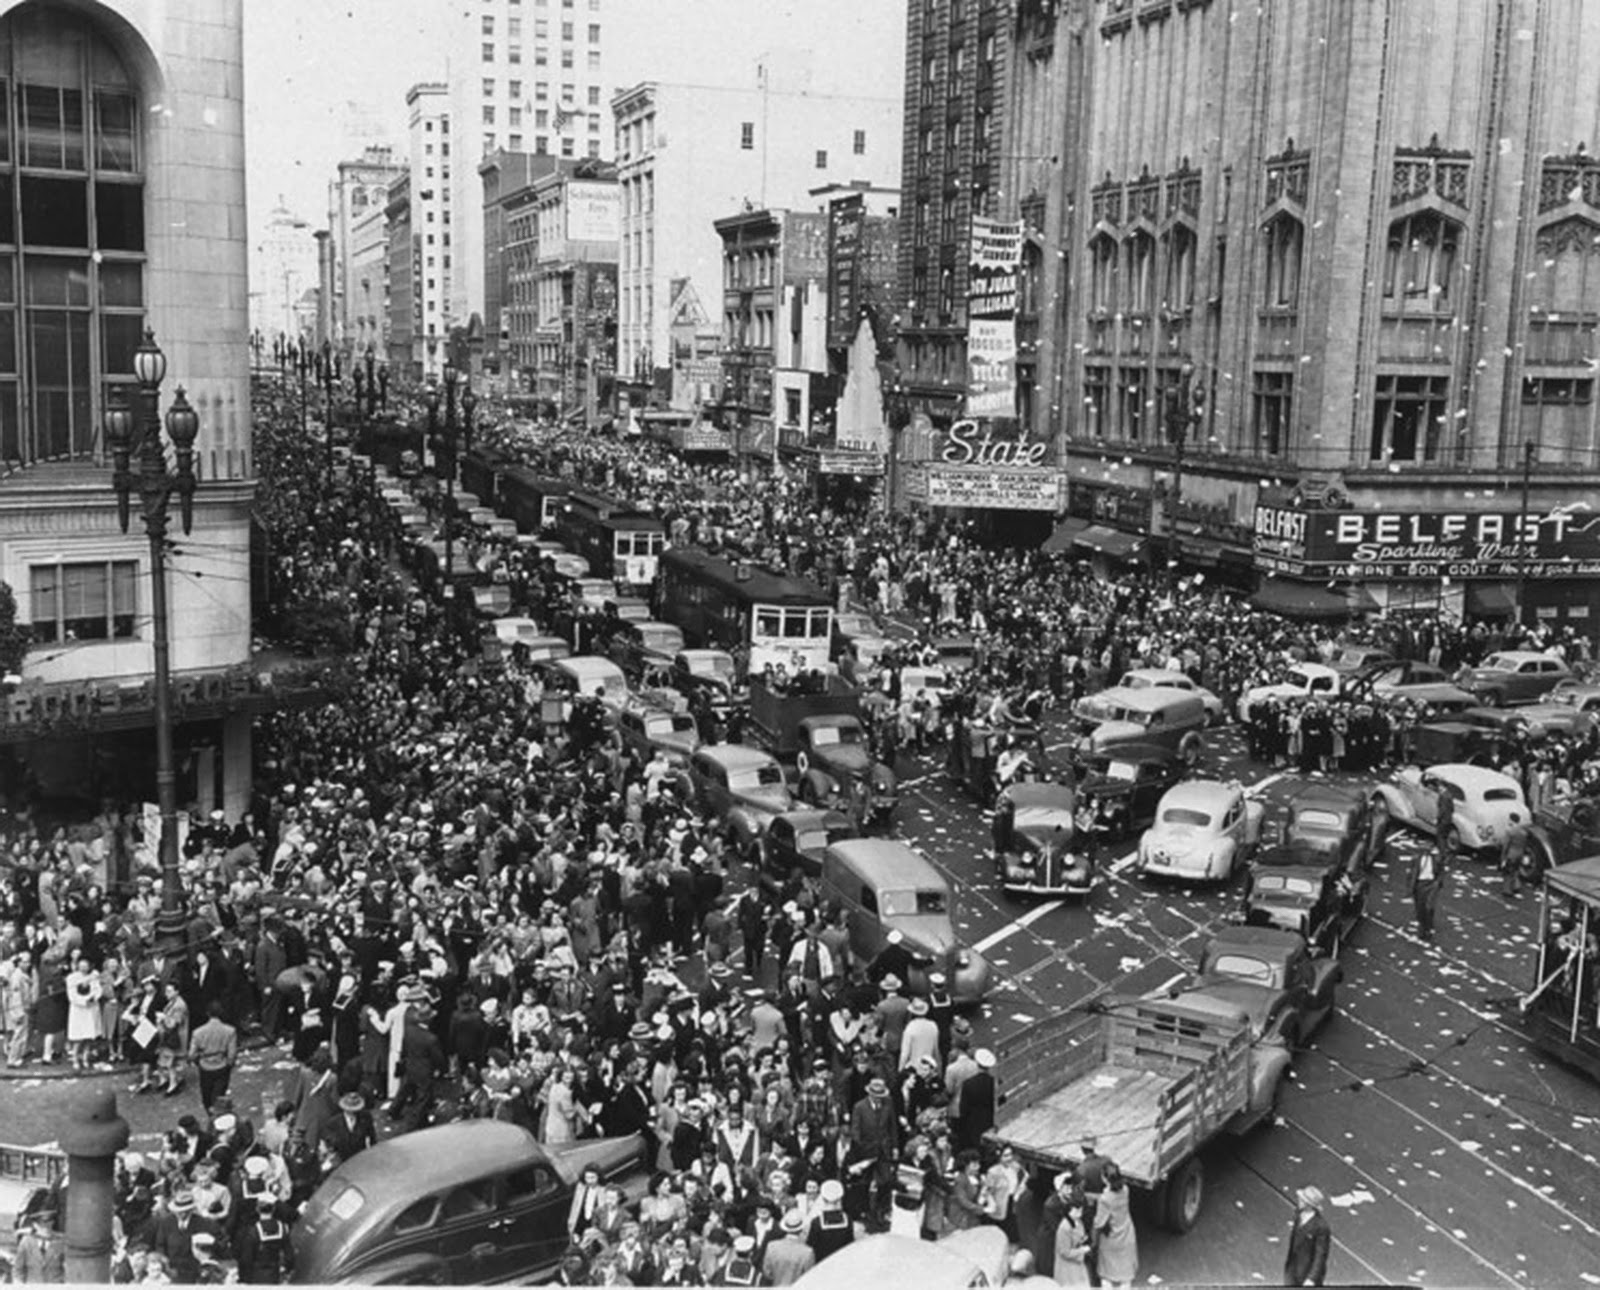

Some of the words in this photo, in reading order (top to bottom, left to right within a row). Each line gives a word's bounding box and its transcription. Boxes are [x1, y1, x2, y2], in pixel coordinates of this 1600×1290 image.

[942, 419, 1047, 466] State
[1255, 506, 1308, 543] BELFAST
[1336, 514, 1573, 544] BELFAST
[1352, 543, 1464, 561] Sparkling
[1476, 542, 1541, 561] Watr
